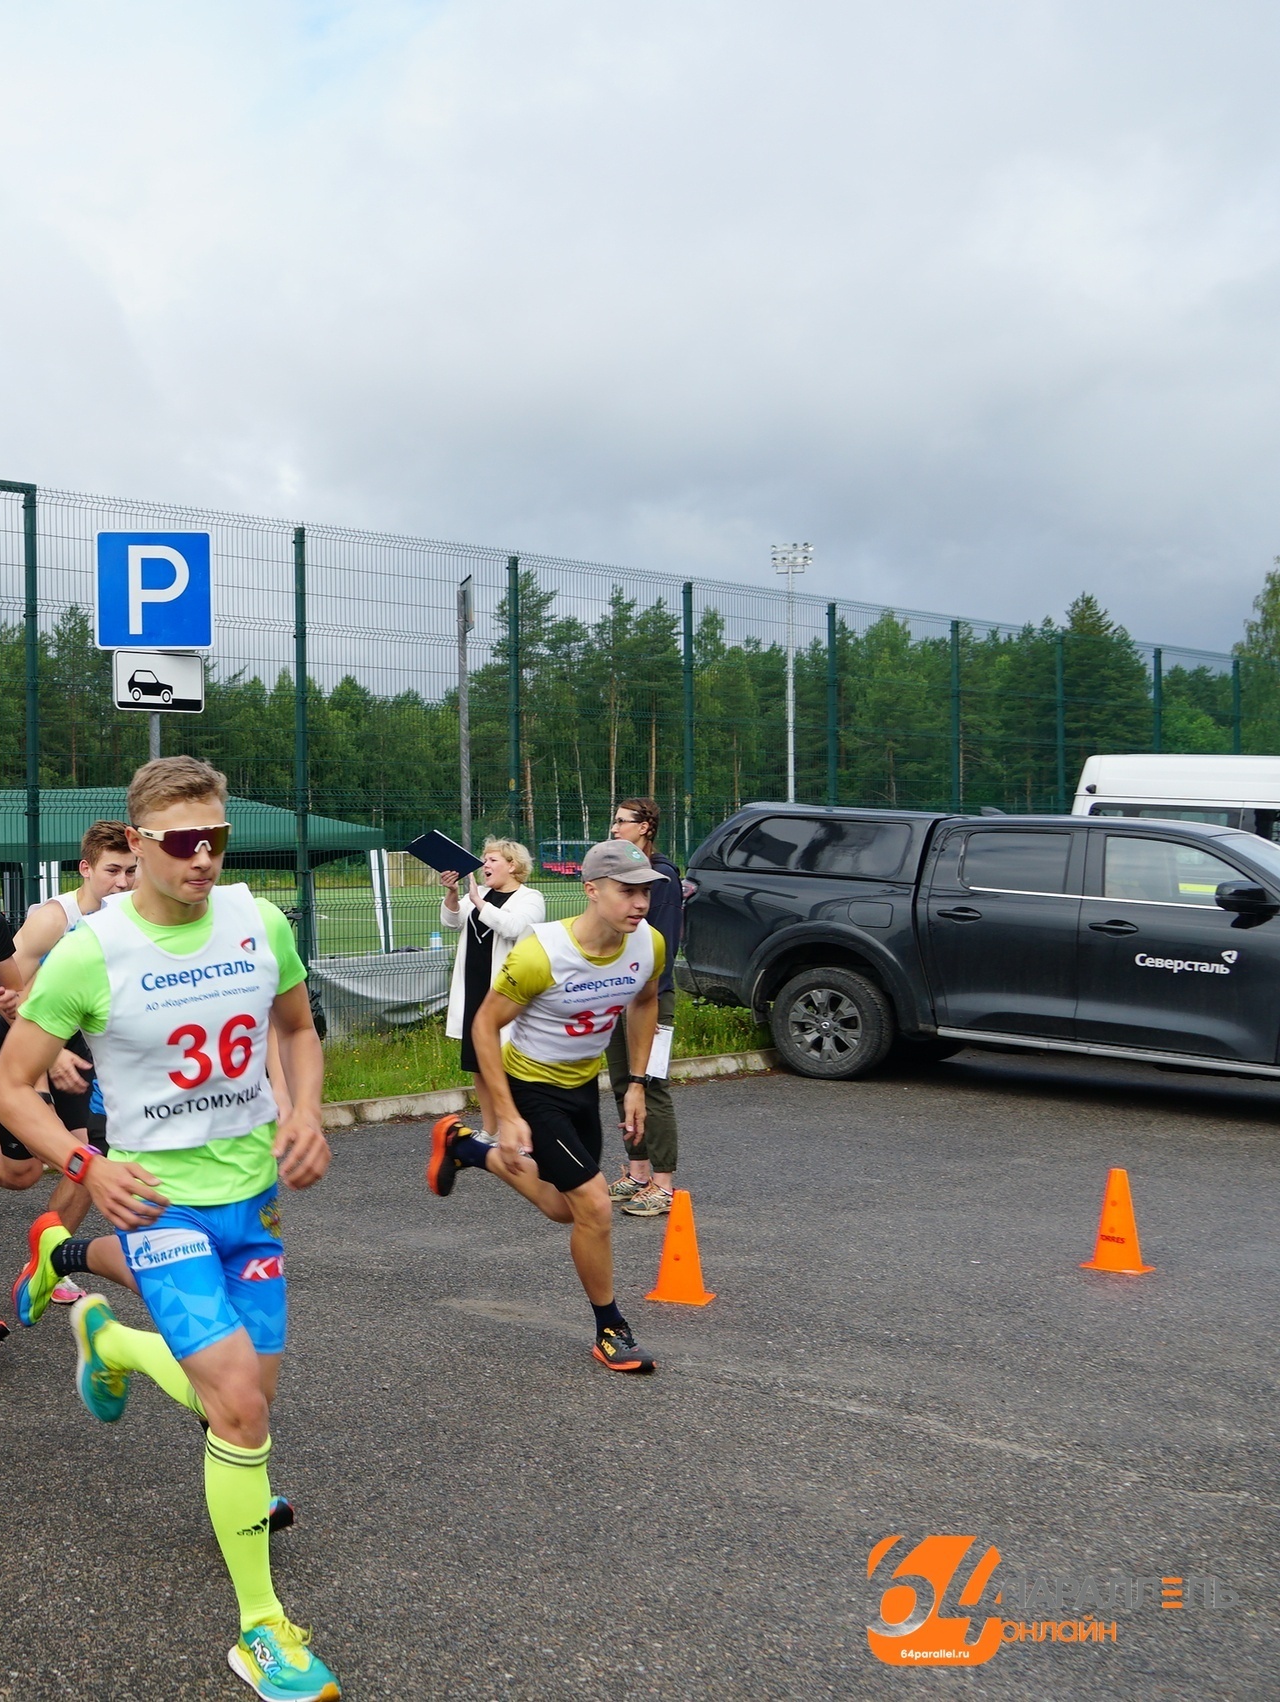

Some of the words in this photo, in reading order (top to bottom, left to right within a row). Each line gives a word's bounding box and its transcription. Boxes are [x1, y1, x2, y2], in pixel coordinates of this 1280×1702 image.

[128, 545, 189, 634] P
[141, 960, 255, 991] Северсталь
[1135, 953, 1230, 974] Северсталь
[565, 976, 636, 992] Северсталь
[145, 1003, 159, 1012] АО
[167, 1014, 257, 1090] 36
[144, 1081, 262, 1120] КОСТОМУКША
[250, 1637, 283, 1680] HOKA
